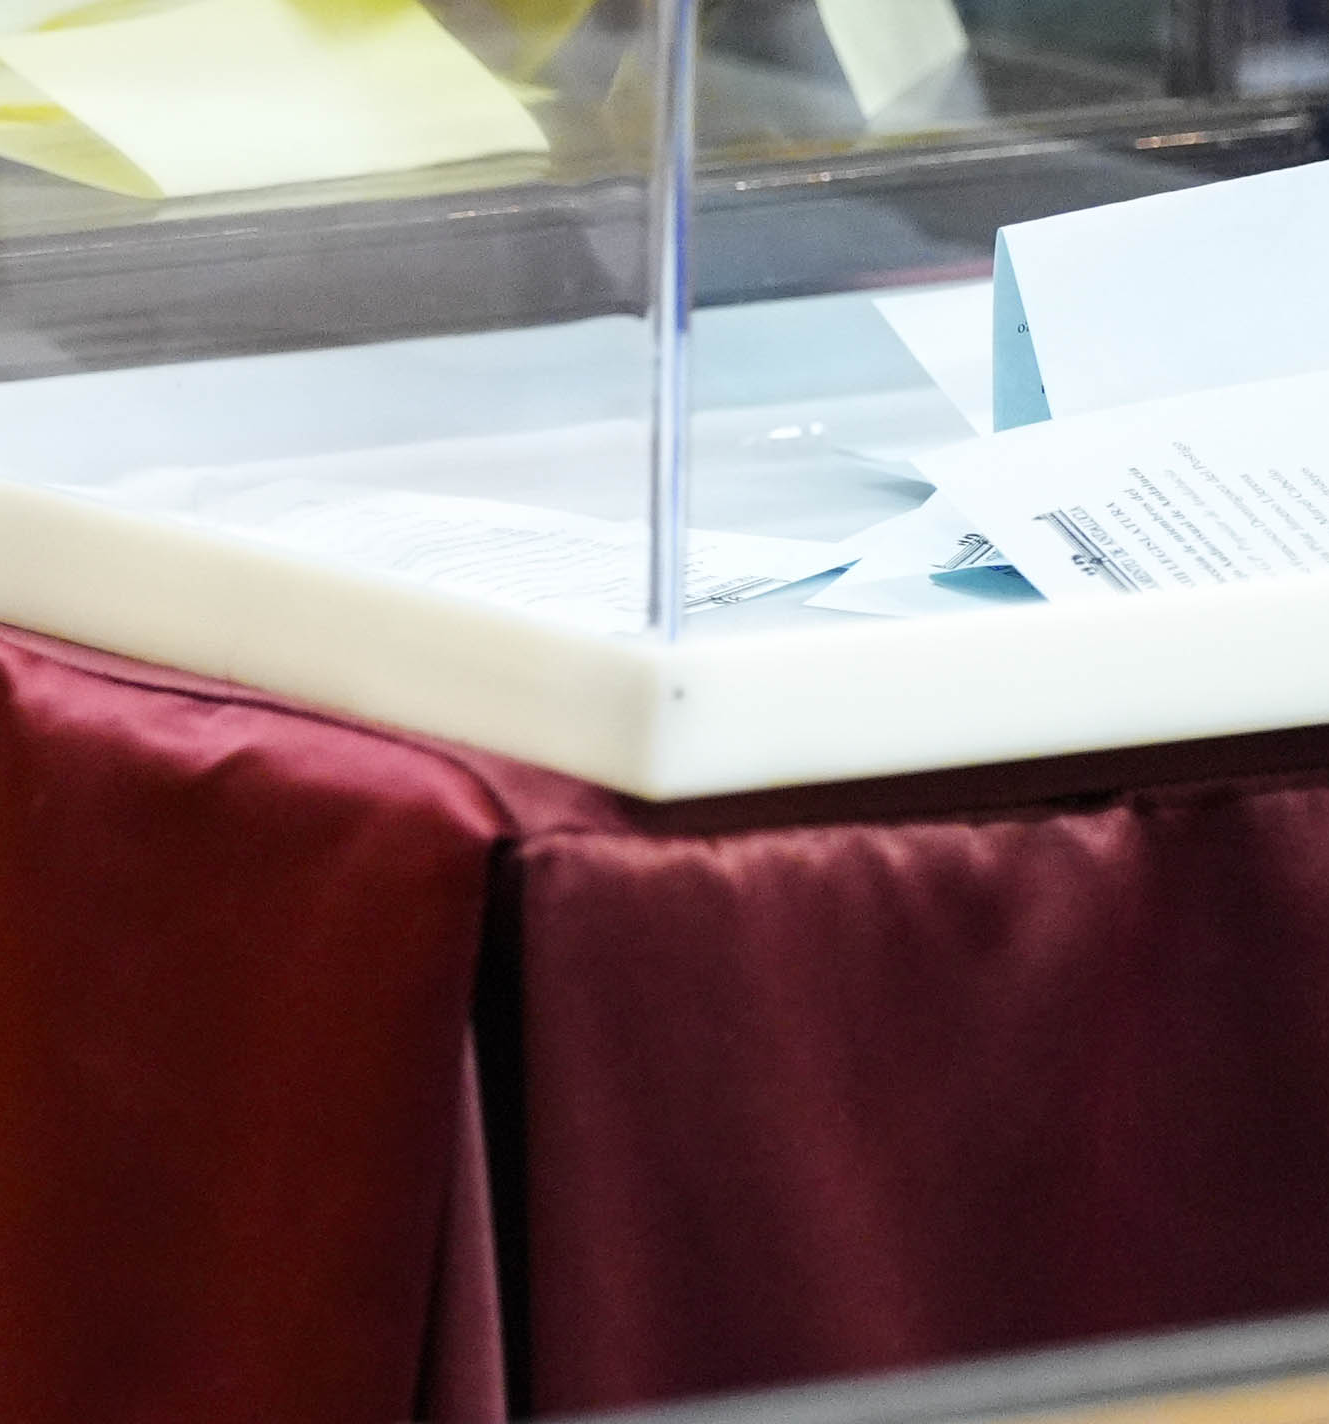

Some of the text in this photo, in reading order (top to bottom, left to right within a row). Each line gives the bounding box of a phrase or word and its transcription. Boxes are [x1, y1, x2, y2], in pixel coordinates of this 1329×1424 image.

[1122, 488, 1144, 502] del
[1128, 467, 1172, 508] Andalucía
[1105, 501, 1179, 571] LEGISLATURA
[1141, 502, 1186, 543] miembros
